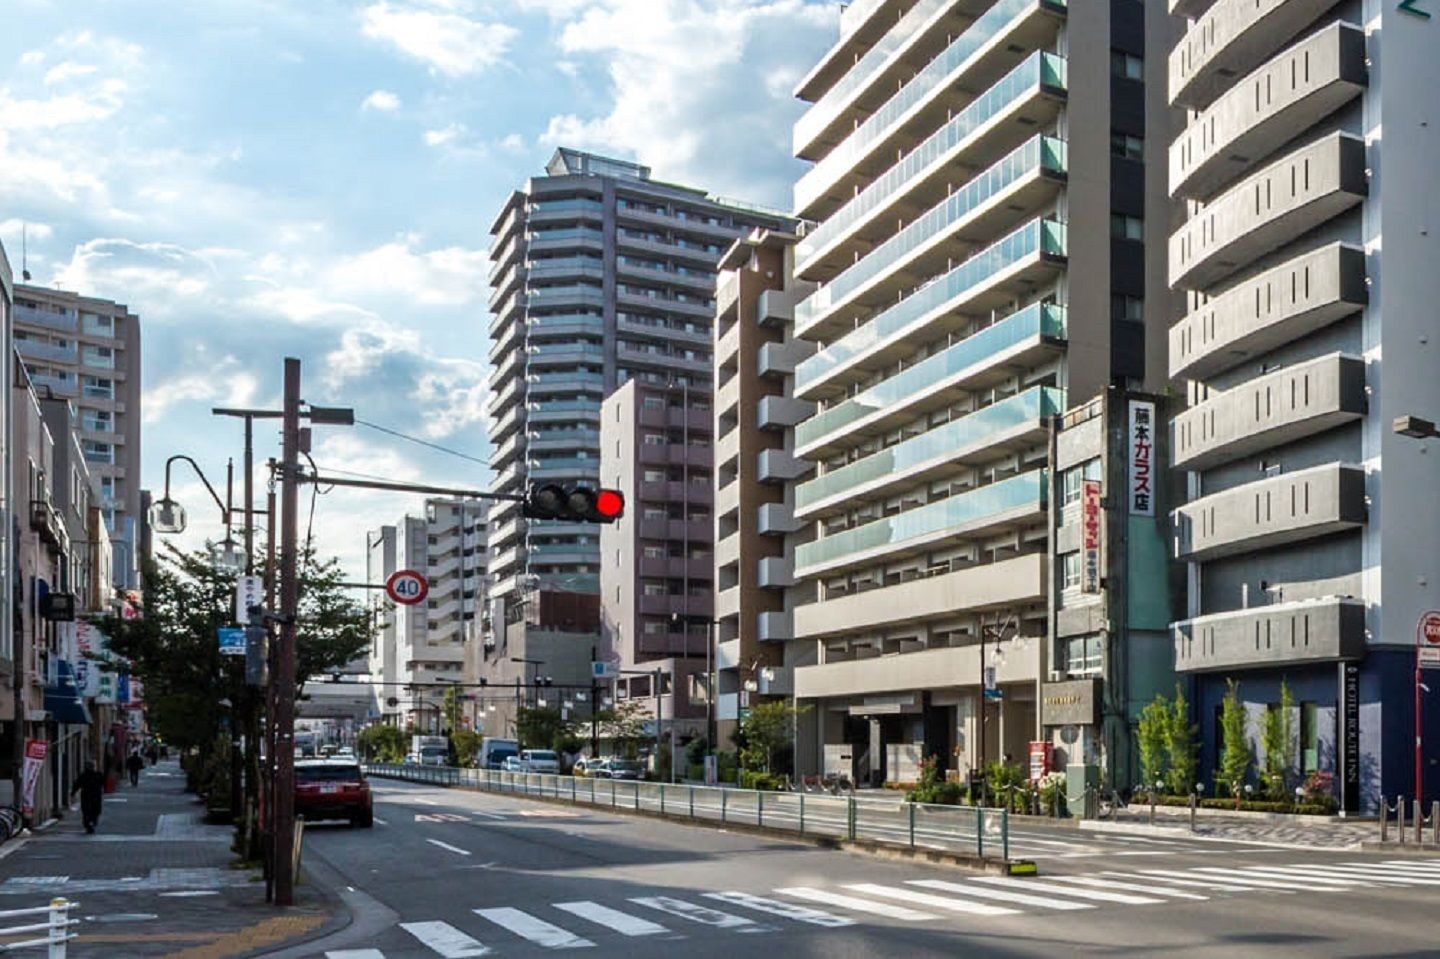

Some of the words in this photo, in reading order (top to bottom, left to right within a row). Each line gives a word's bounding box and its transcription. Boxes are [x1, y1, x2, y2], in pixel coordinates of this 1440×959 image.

[1135, 408, 1151, 511] 藤本ガラス店
[396, 580, 419, 596] 40
